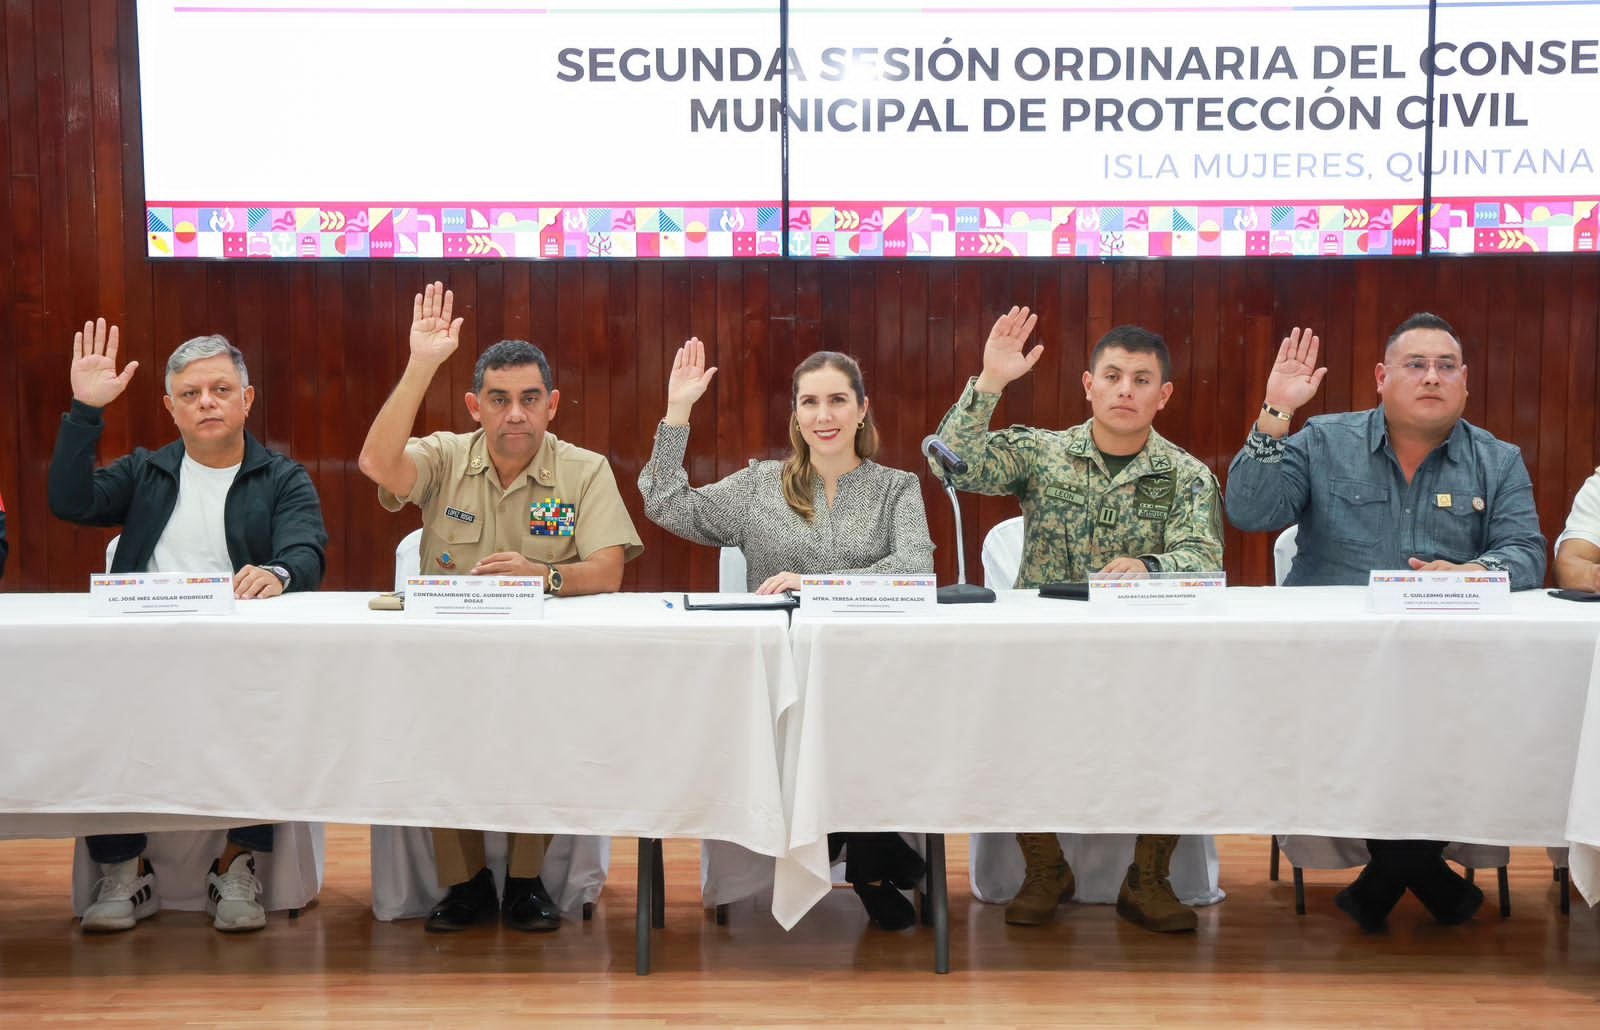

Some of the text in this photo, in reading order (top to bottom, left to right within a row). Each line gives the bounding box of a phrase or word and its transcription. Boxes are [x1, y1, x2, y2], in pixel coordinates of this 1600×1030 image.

[556, 36, 1600, 82] SEGUNDA SESIÓN ORDINARIA DEL CONSE
[690, 86, 1529, 133] MUNICIPAL DE PROTECCIÓN CIVIL
[1103, 148, 1595, 182] ISLA MUJERES, QUINTANA
